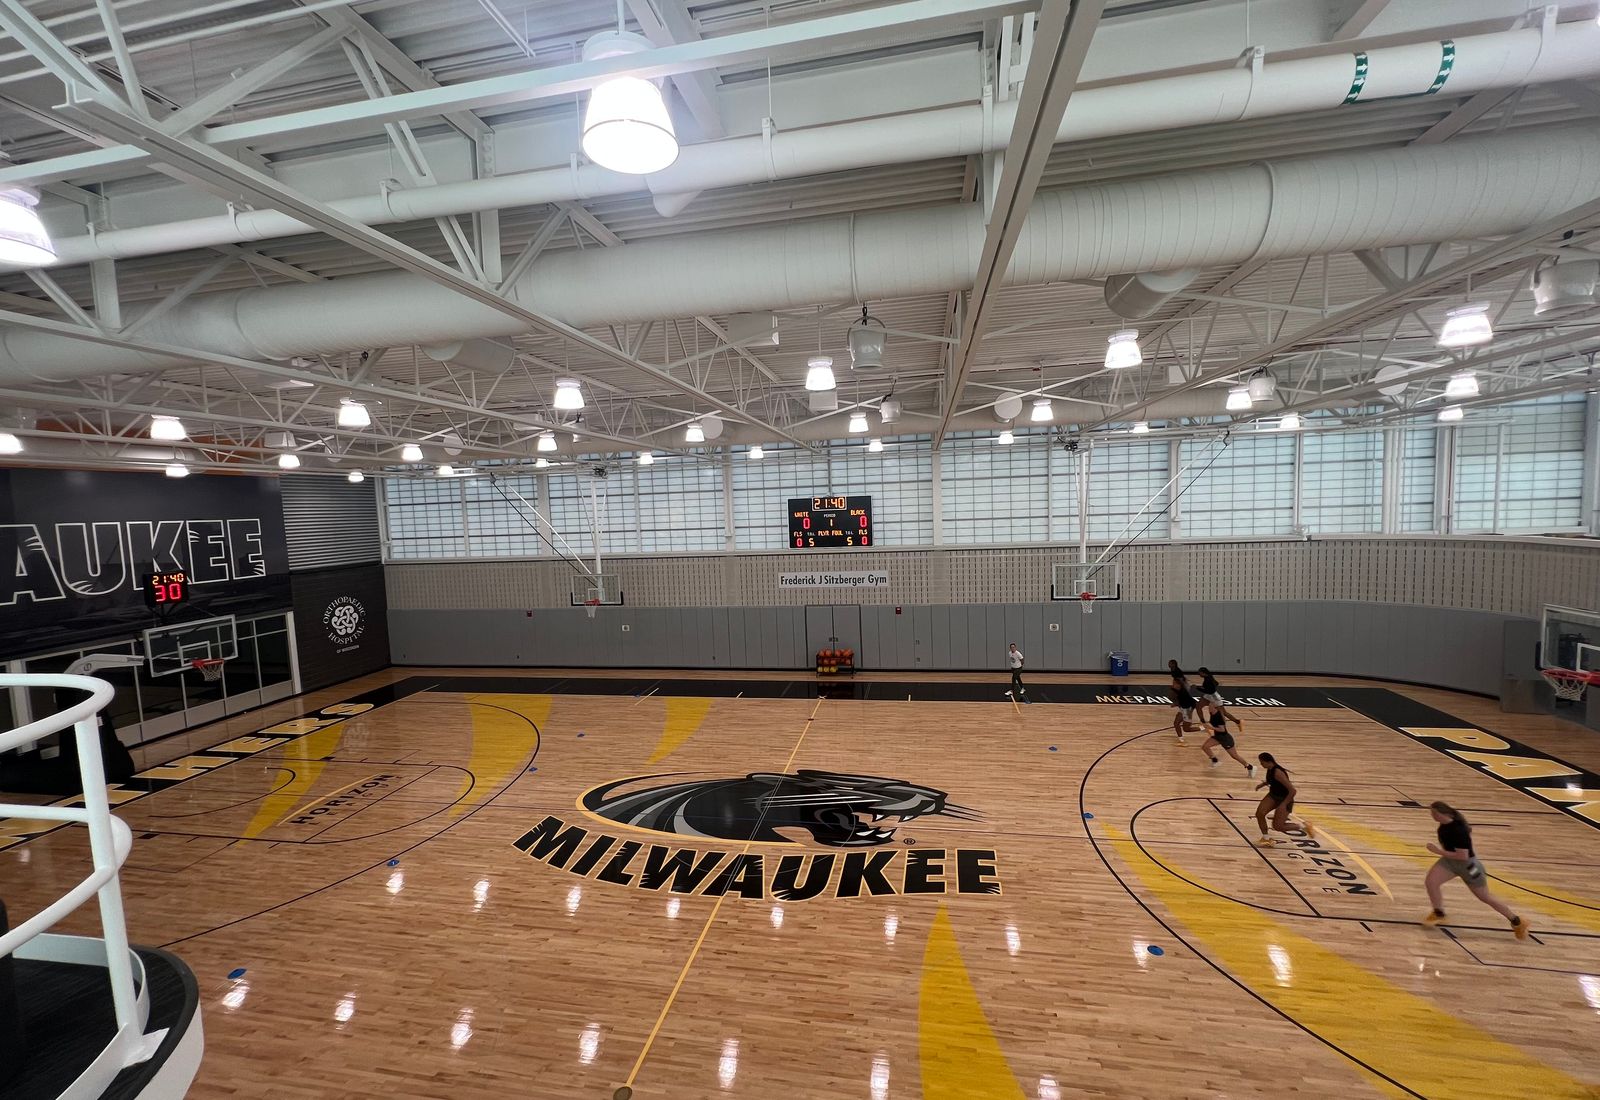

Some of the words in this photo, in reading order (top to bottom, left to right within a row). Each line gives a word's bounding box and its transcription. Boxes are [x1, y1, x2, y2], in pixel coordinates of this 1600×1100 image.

[814, 497, 845, 509] 21:40
[803, 517, 810, 529] 0
[829, 518, 833, 527] 1
[859, 515, 867, 528] 0
[796, 538, 803, 547] 0
[861, 536, 868, 545] 0
[152, 573, 184, 585] 21:40
[780, 575, 816, 585] Frederick
[818, 575, 823, 585] J
[824, 575, 865, 586] Sitzberger
[867, 574, 887, 586] Gym
[155, 584, 182, 601] 30
[322, 596, 366, 624] ORTHOPAEDIC
[328, 625, 365, 645] HOSPITAL
[289, 774, 394, 825] HORIZON
[511, 815, 1004, 901] MILWAUKEE
